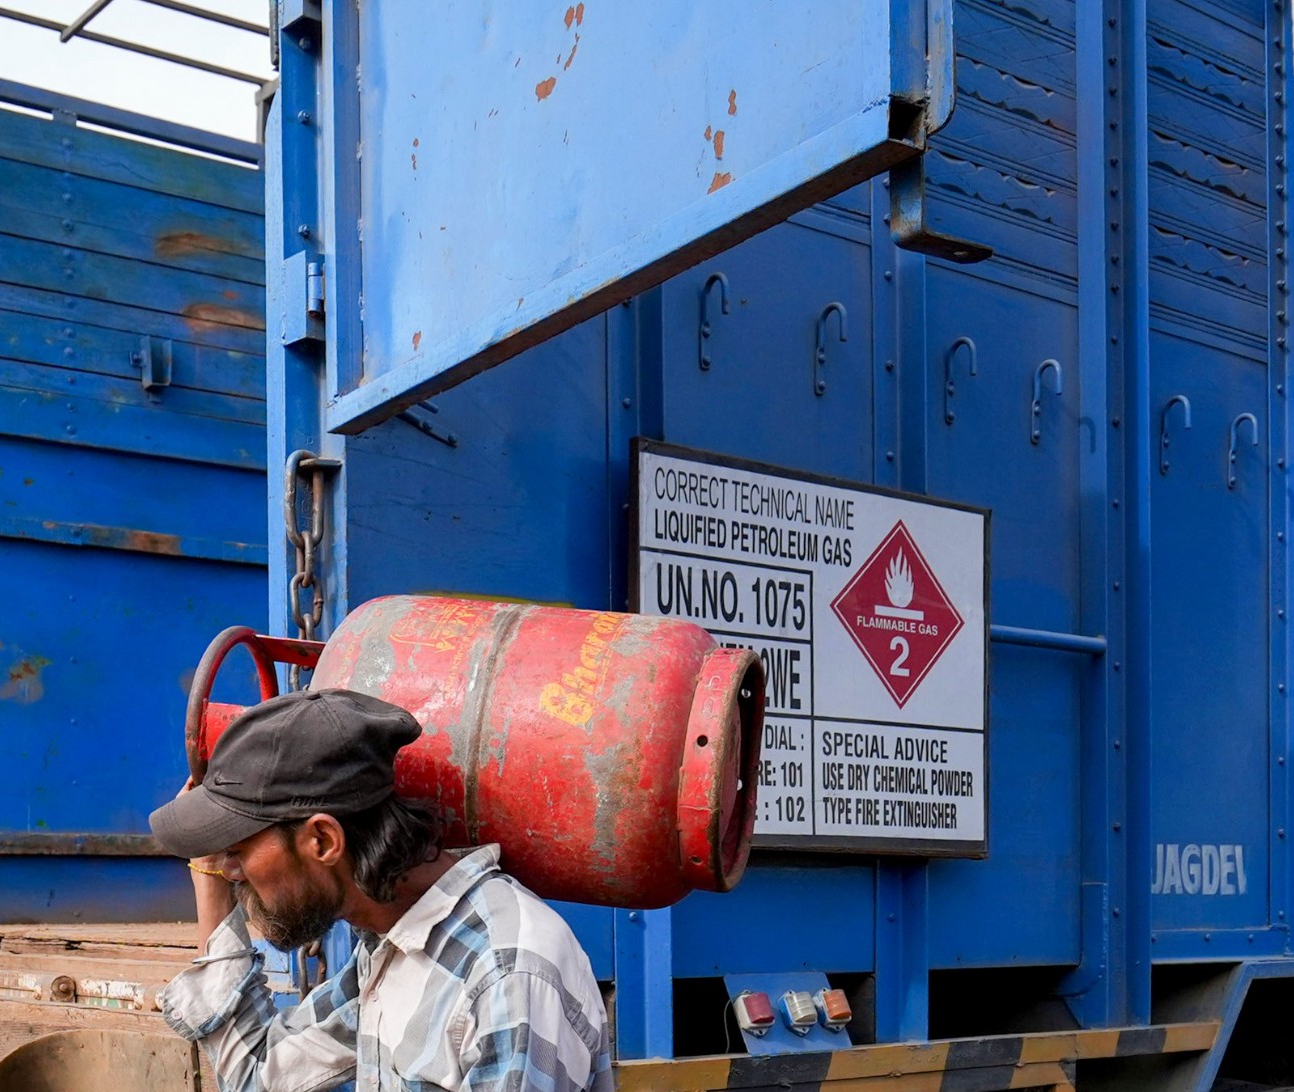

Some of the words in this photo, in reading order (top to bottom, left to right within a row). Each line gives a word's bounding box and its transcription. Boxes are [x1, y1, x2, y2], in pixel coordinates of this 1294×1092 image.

[655, 467, 728, 511] CORRECT
[732, 481, 811, 524] TECHNICAL
[815, 497, 854, 531] NAME
[655, 509, 727, 549] LIQUIFIED
[731, 522, 818, 563] PETROLEUM
[823, 536, 852, 567] GAS
[656, 563, 743, 623] UN.NO.
[752, 577, 805, 631] 1075
[857, 615, 916, 634] FLAMMABLE
[918, 623, 938, 637] GAS
[890, 636, 910, 677] 2
[765, 724, 796, 751] DIAL
[822, 731, 889, 759] SPECIAL
[895, 737, 948, 764] ADVICE
[757, 760, 776, 787] RE:
[781, 764, 804, 788] 101
[822, 763, 844, 790] USE
[848, 764, 870, 792] DRY
[873, 765, 928, 795] CHEMICAL
[931, 769, 973, 798] POWDER
[776, 796, 805, 823] 102
[823, 796, 852, 825] TYPE
[855, 798, 880, 826] FIRE
[883, 800, 957, 830] EXTINGUISHER
